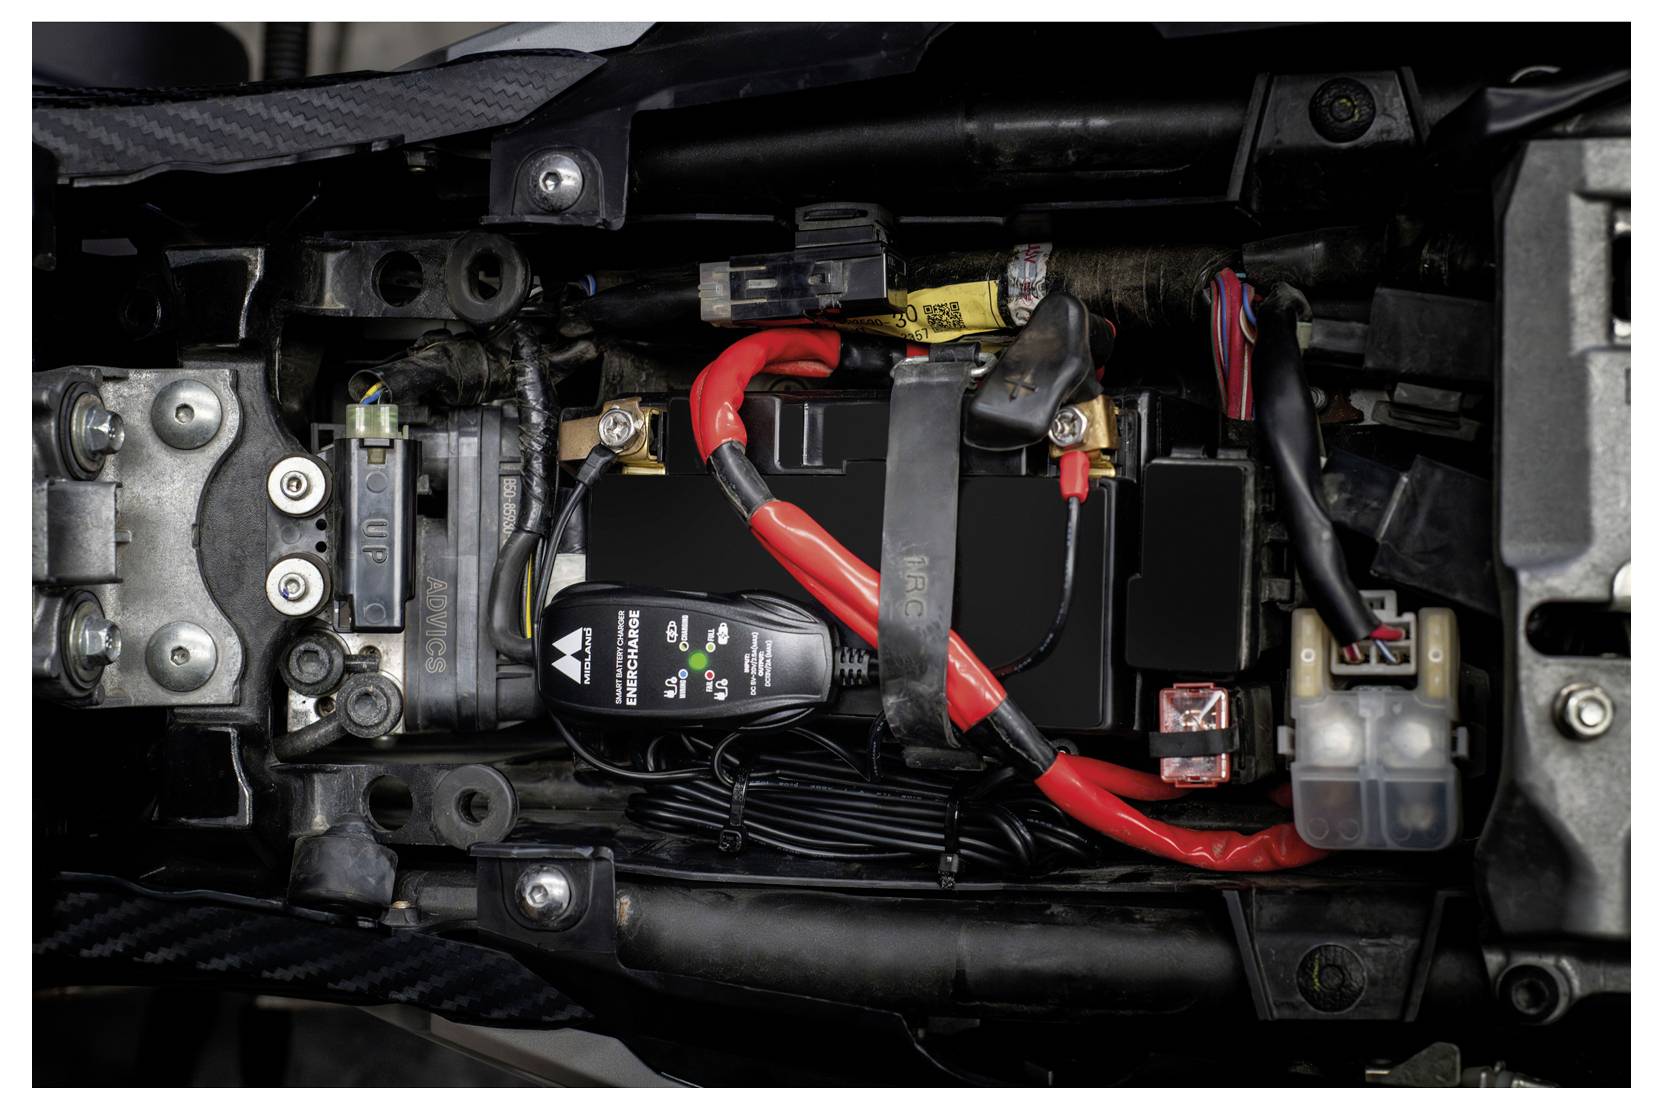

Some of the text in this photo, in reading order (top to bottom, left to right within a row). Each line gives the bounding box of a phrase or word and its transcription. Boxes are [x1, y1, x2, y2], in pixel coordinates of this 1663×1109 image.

[362, 518, 389, 564] UP
[426, 576, 448, 674] ADVICS
[617, 610, 625, 646] CHARGER
[707, 629, 715, 642] FULL
[583, 627, 593, 685] MIDLAND
[616, 647, 624, 679] BATTERY
[626, 610, 640, 706] ENERCHARGE
